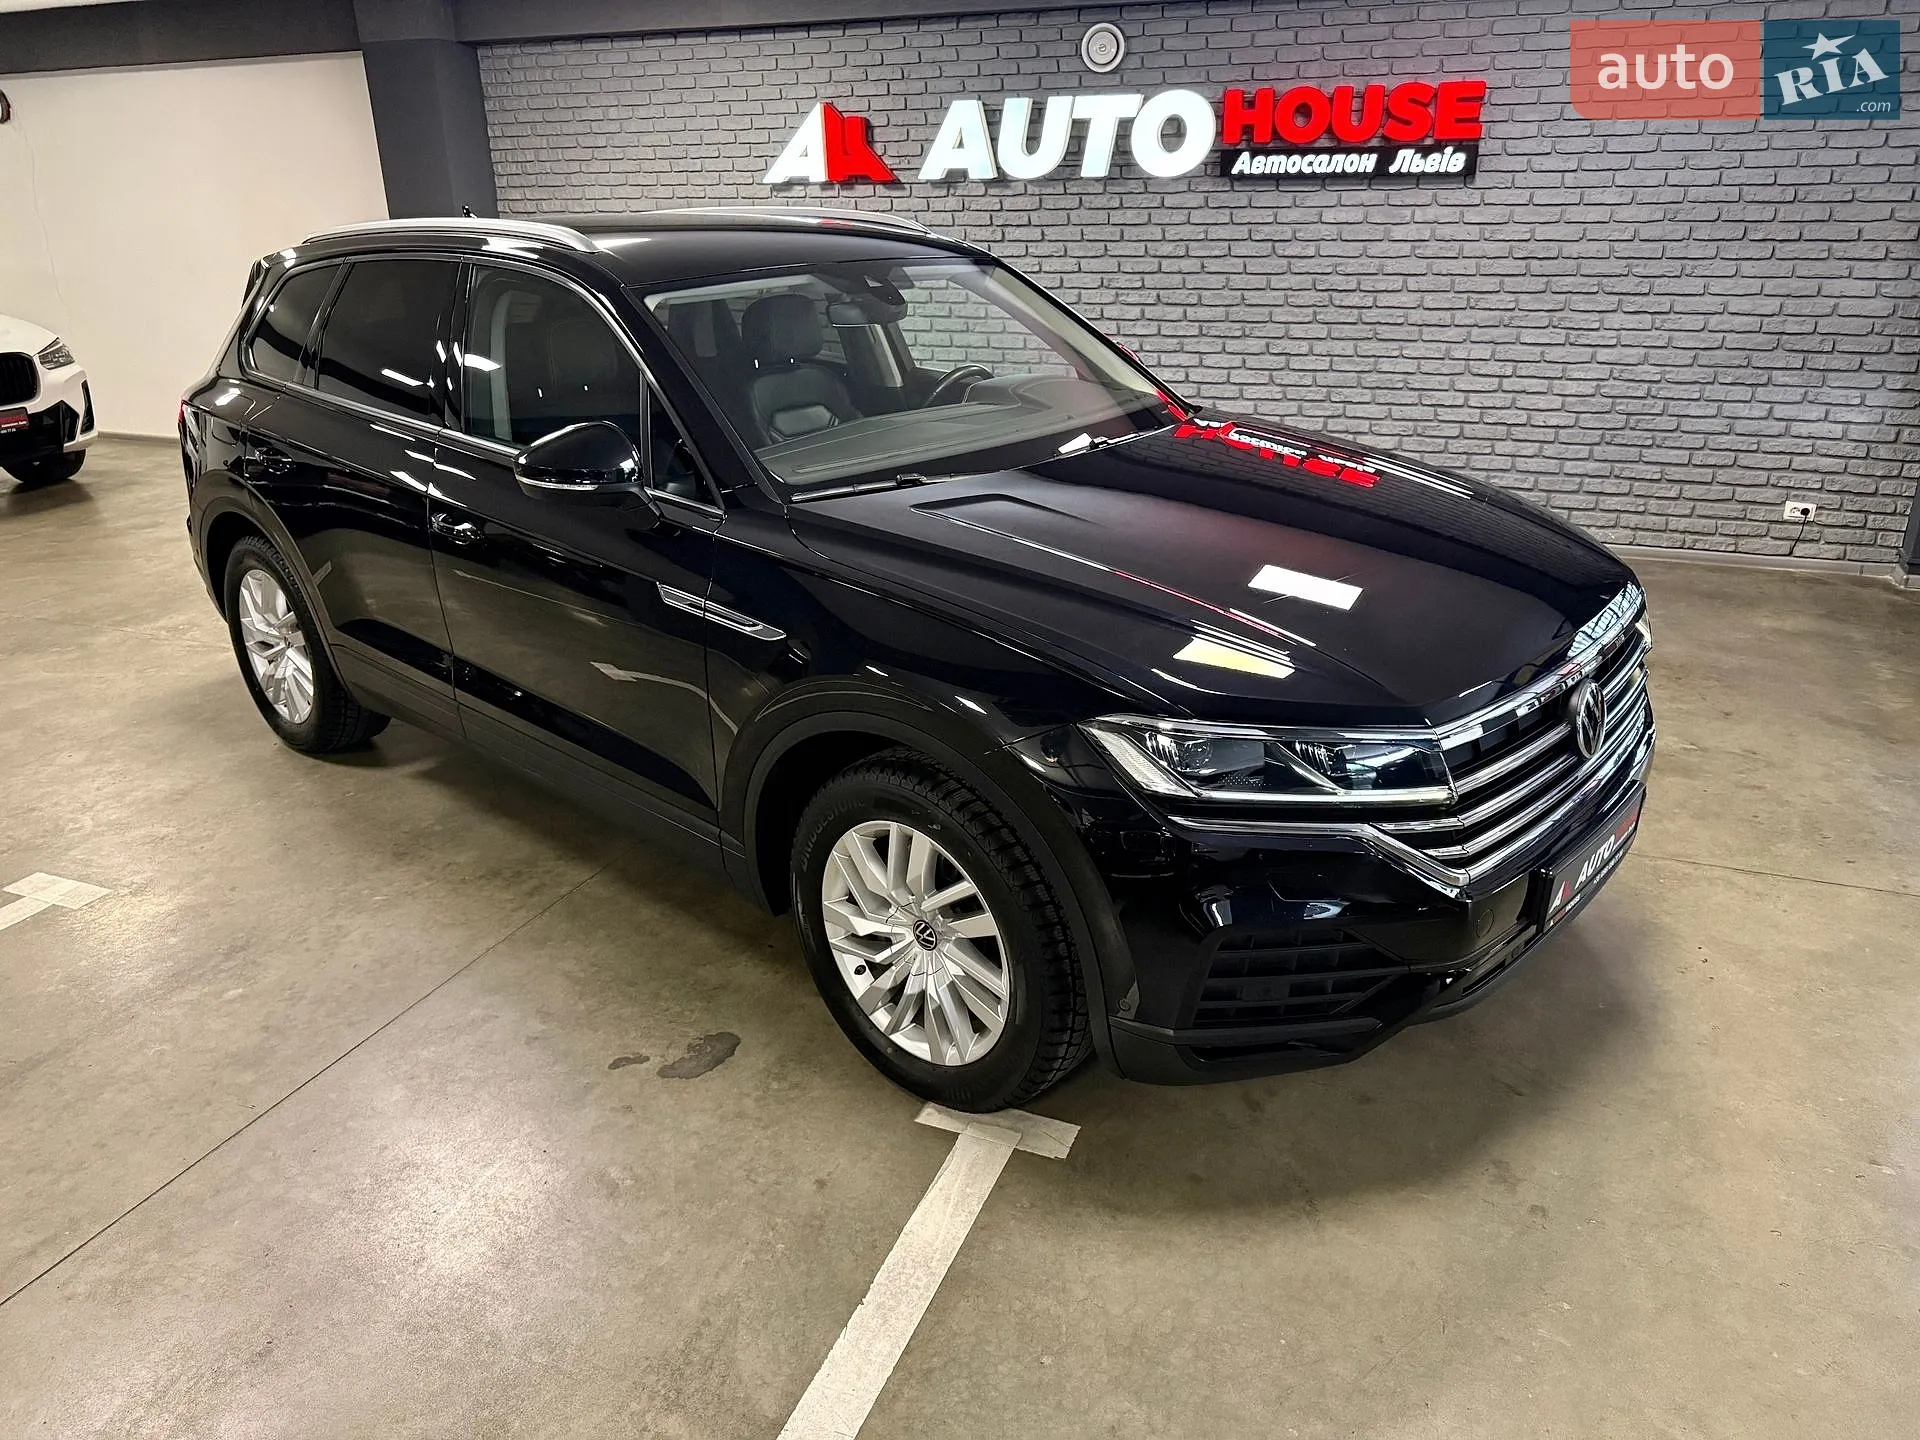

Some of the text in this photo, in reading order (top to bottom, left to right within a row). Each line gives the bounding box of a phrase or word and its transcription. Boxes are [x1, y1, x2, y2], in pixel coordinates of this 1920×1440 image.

[918, 89, 1216, 180] AUTO
[1222, 80, 1487, 145] HOUSE
[1231, 146, 1467, 175] Автосалон Львів
[1574, 834, 1615, 890] AUTO
